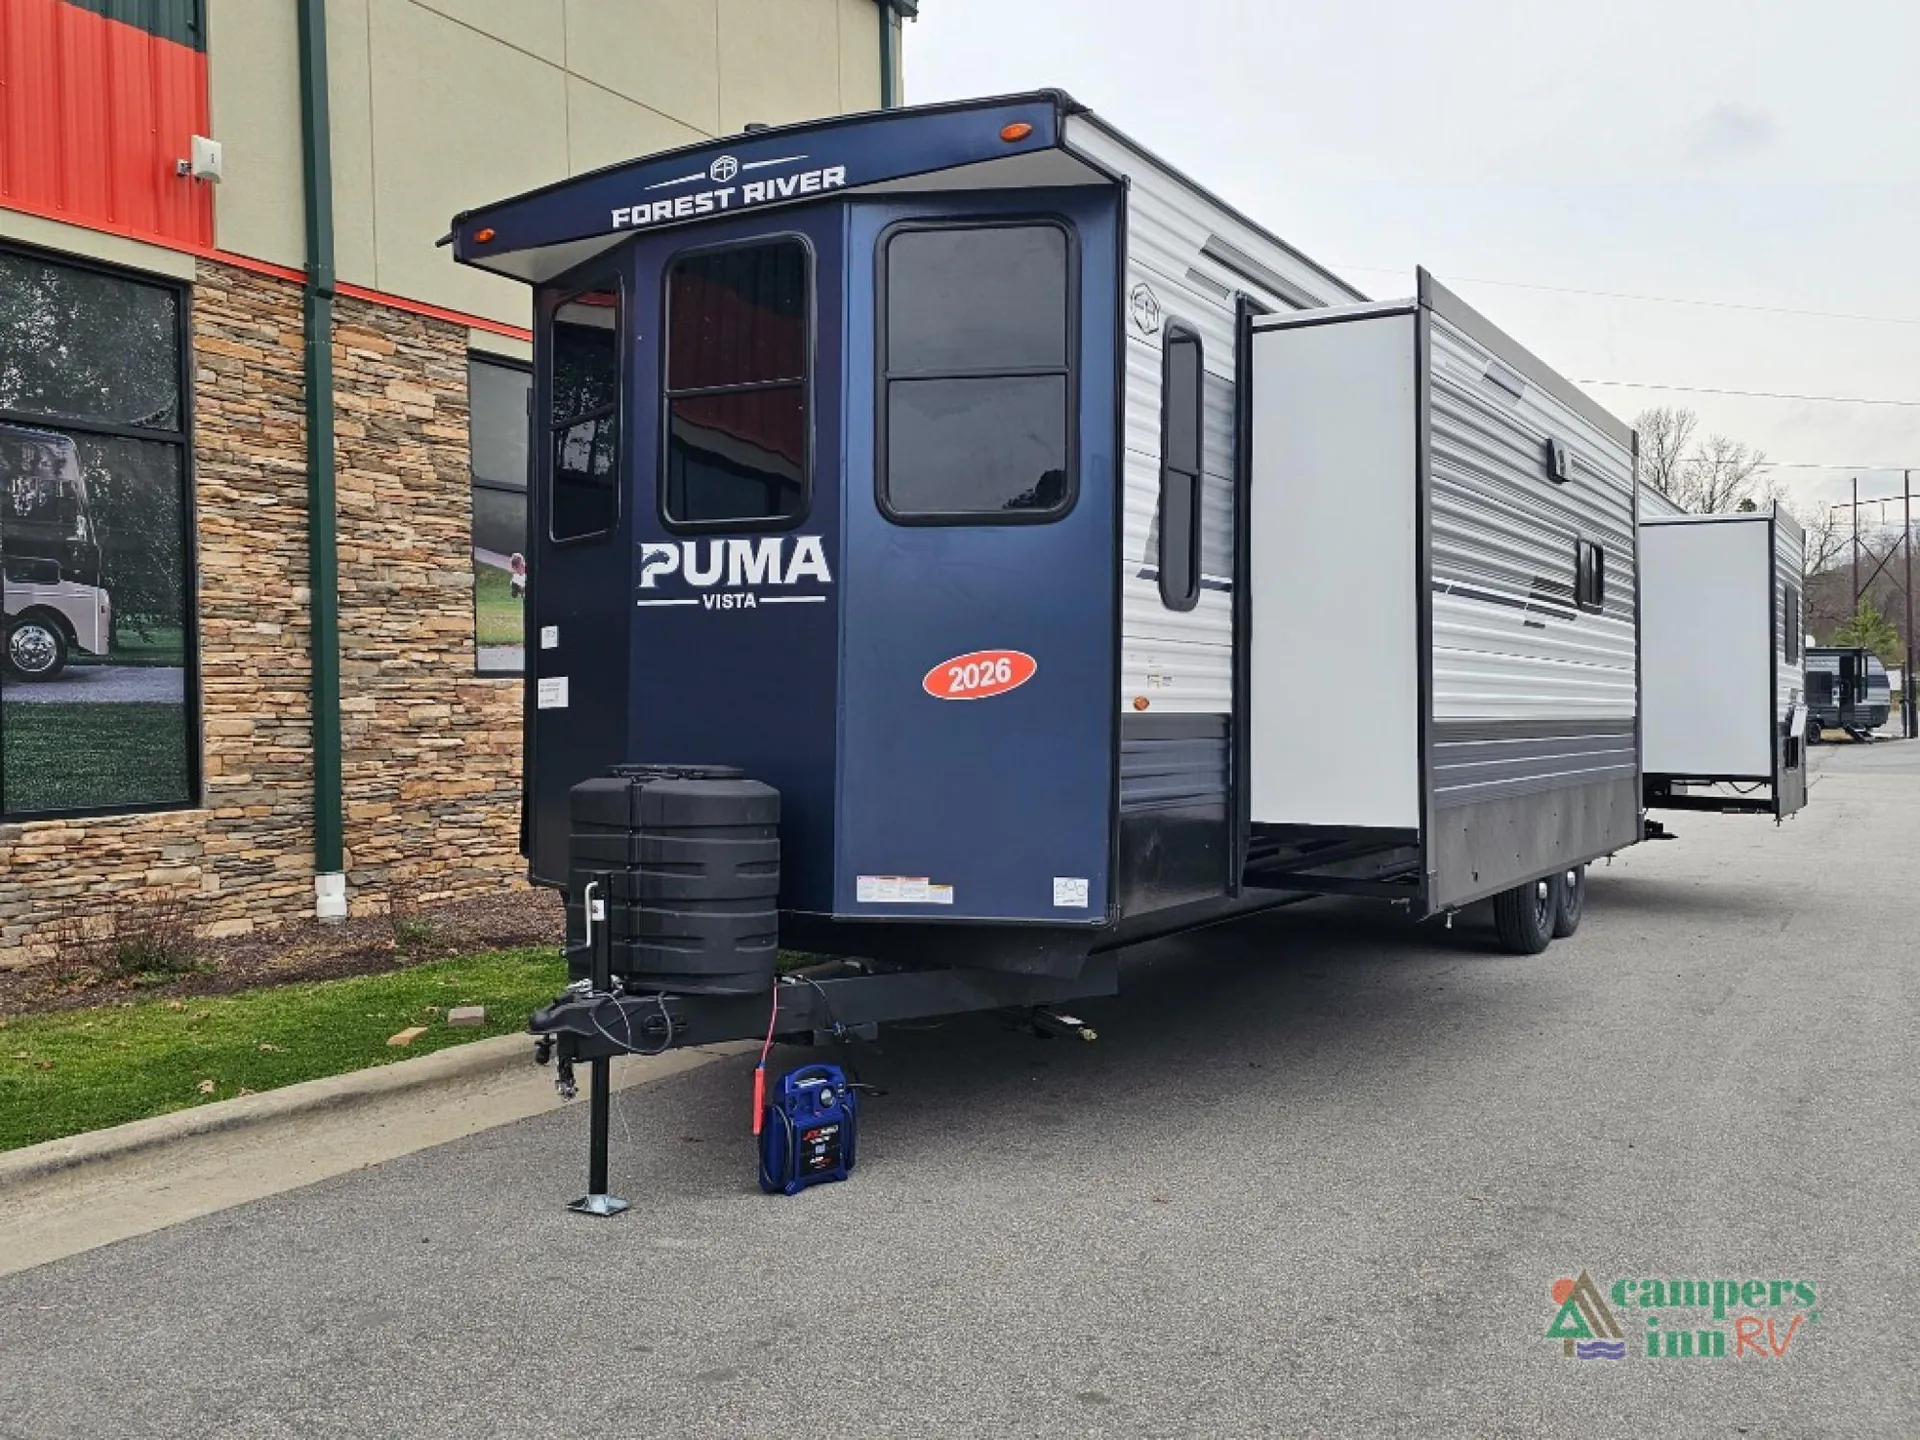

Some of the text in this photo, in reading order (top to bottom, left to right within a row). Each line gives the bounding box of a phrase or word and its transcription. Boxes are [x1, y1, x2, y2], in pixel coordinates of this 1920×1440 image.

[612, 165, 845, 228] FOREST RIVER
[639, 536, 832, 588] PUMA
[702, 593, 757, 609] VISTA
[948, 657, 1011, 692] 2026
